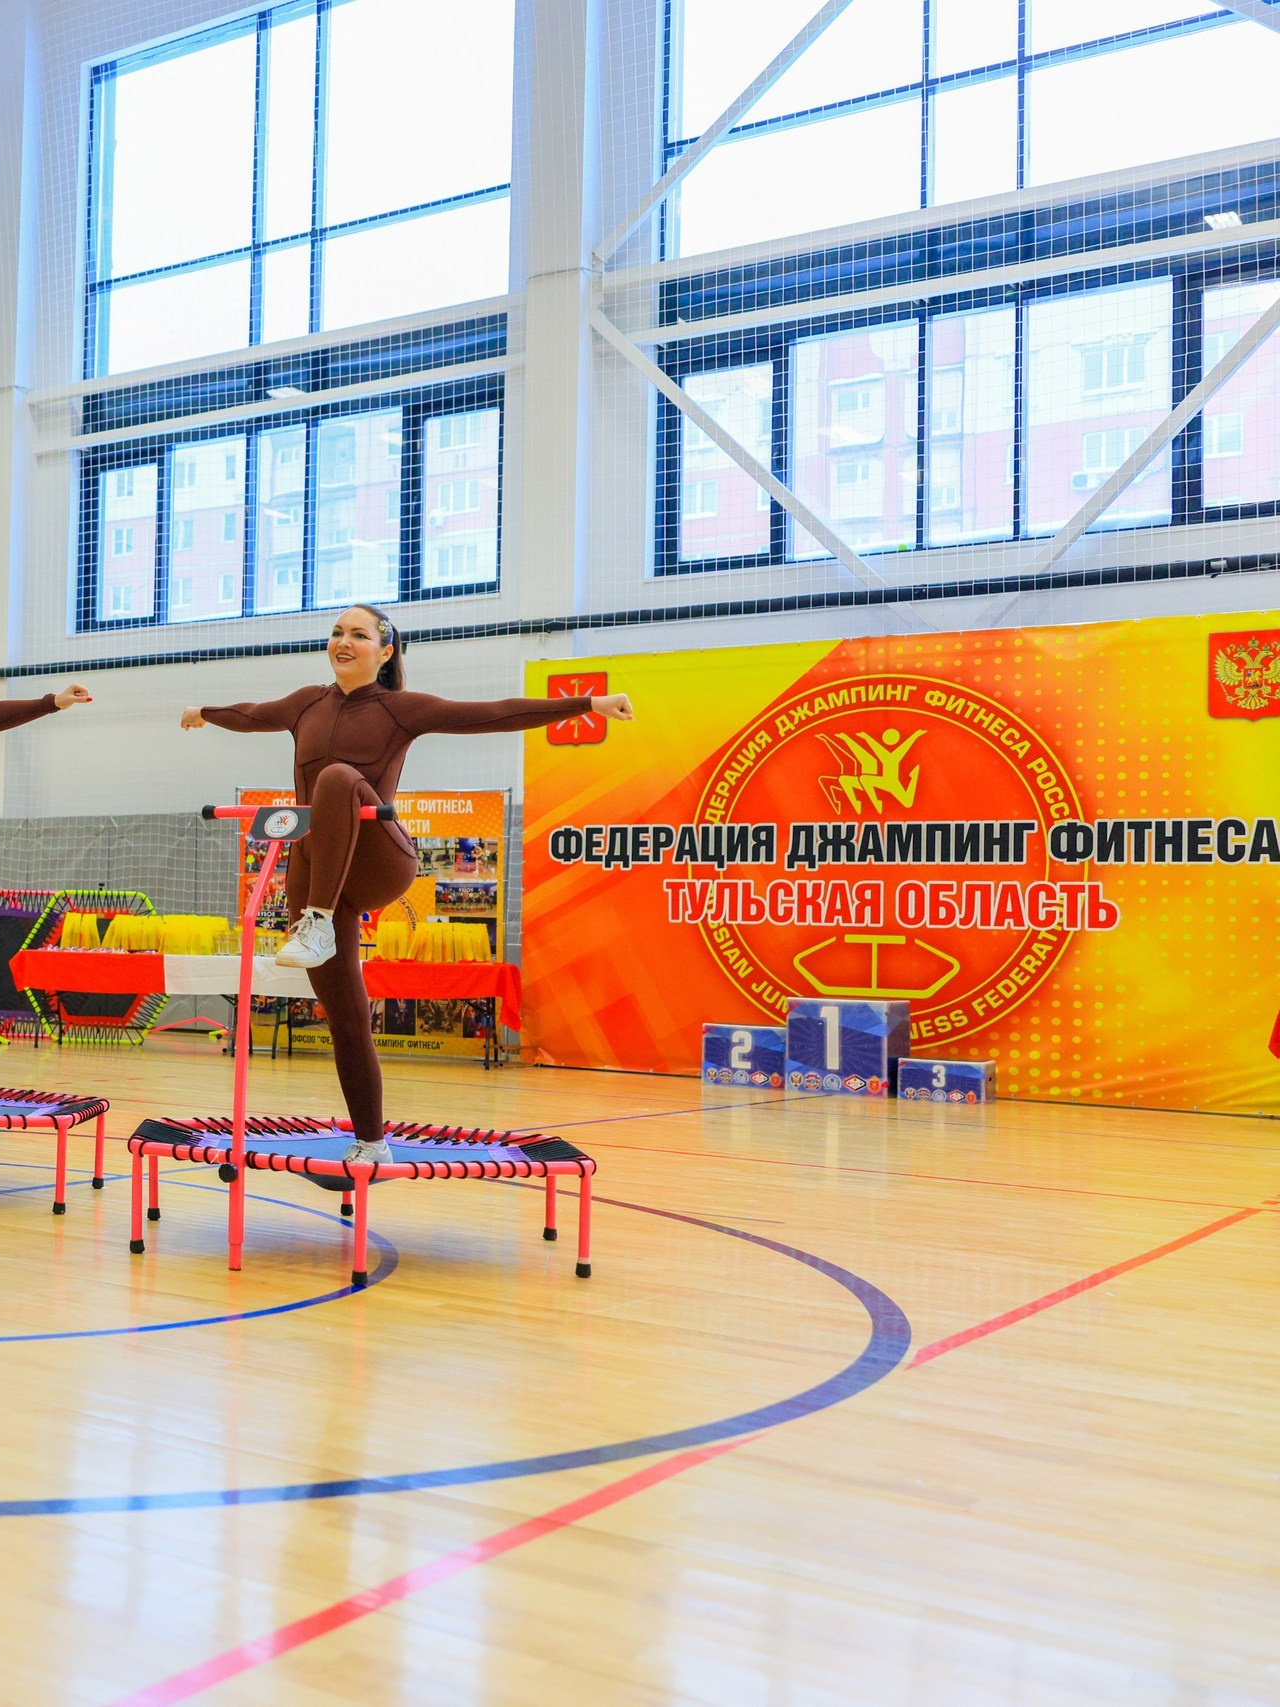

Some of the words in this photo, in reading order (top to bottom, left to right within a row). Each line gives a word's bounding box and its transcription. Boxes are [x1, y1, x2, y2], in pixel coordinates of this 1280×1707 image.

[704, 730, 773, 824] ДЕРАЦИЯ
[774, 684, 917, 737] ДЖАМПИНГ
[924, 689, 1034, 760] ФИТНЕСА
[1026, 757, 1072, 824] РОСС
[399, 819, 431, 834] АСТИ
[416, 799, 474, 814] ФИТНЕСА
[550, 823, 777, 870] ФЕДЕРАЦИЯ
[785, 820, 1038, 871] ДЖАМПИНГ
[1048, 818, 1280, 865] ФИТНЕСА
[664, 879, 884, 928] ТУЛЬСКАЯ
[895, 879, 1121, 931] ОБЛАСТЬ
[373, 1038, 406, 1048] АМПИНГ
[731, 1031, 752, 1069] 2
[820, 1006, 840, 1070] 1
[932, 1064, 946, 1088] 3
